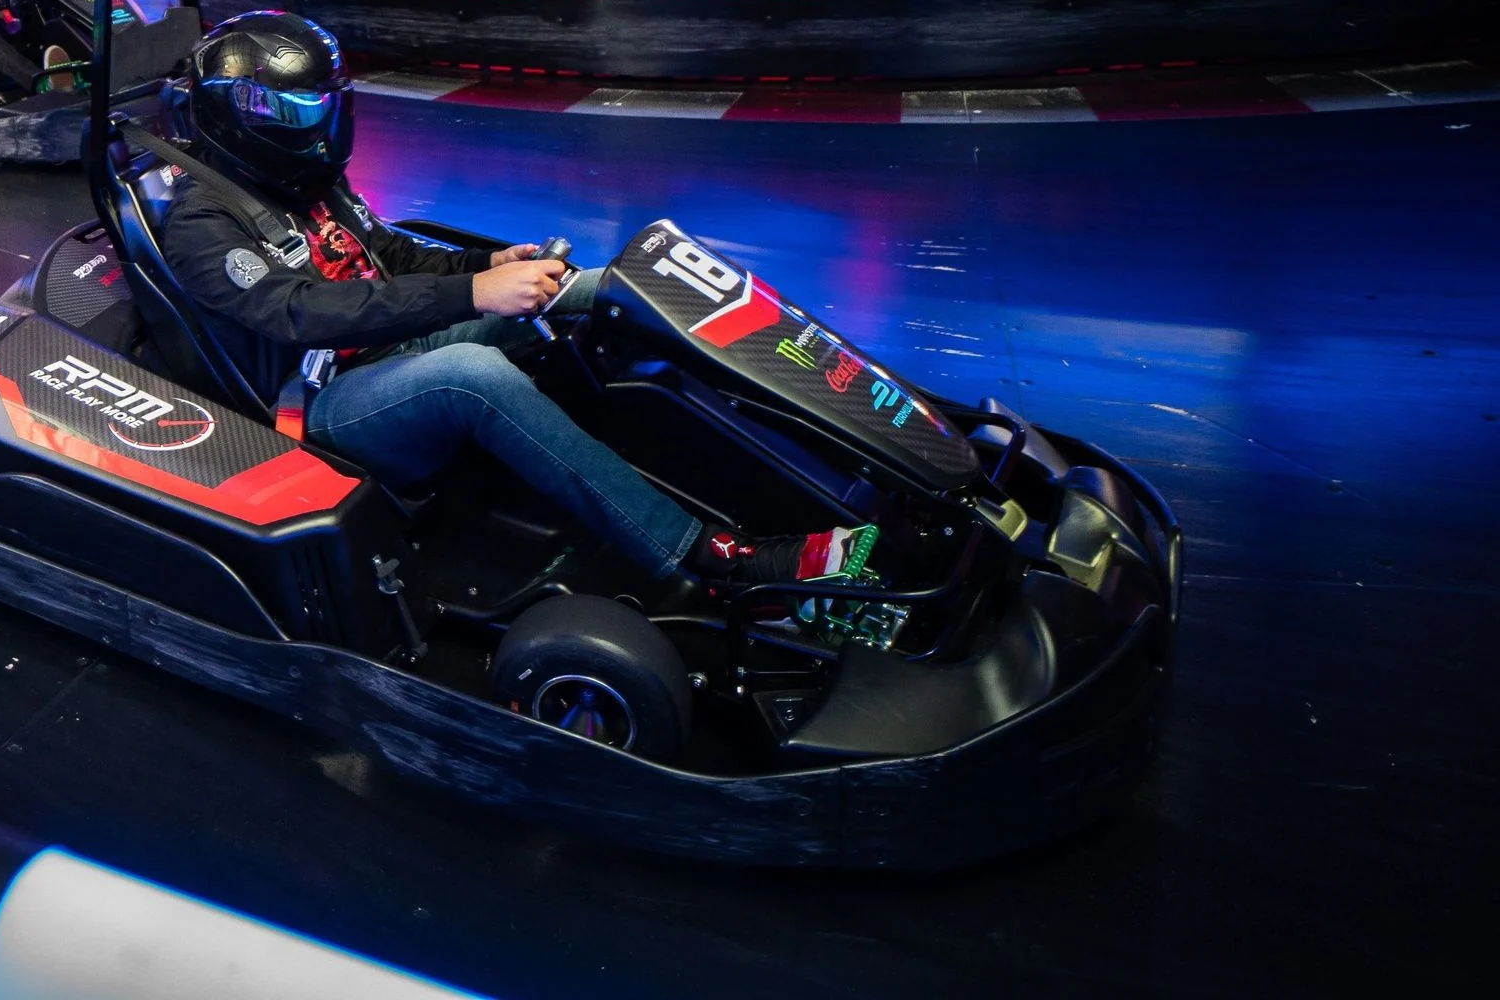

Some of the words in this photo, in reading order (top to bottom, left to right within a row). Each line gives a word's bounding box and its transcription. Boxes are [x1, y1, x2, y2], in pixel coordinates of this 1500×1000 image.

[652, 242, 740, 303] 18
[794, 322, 819, 348] MONSTER
[30, 369, 68, 391] RACE
[66, 388, 103, 408] PLAY
[100, 405, 144, 429] MORE
[43, 355, 174, 421] RPM
